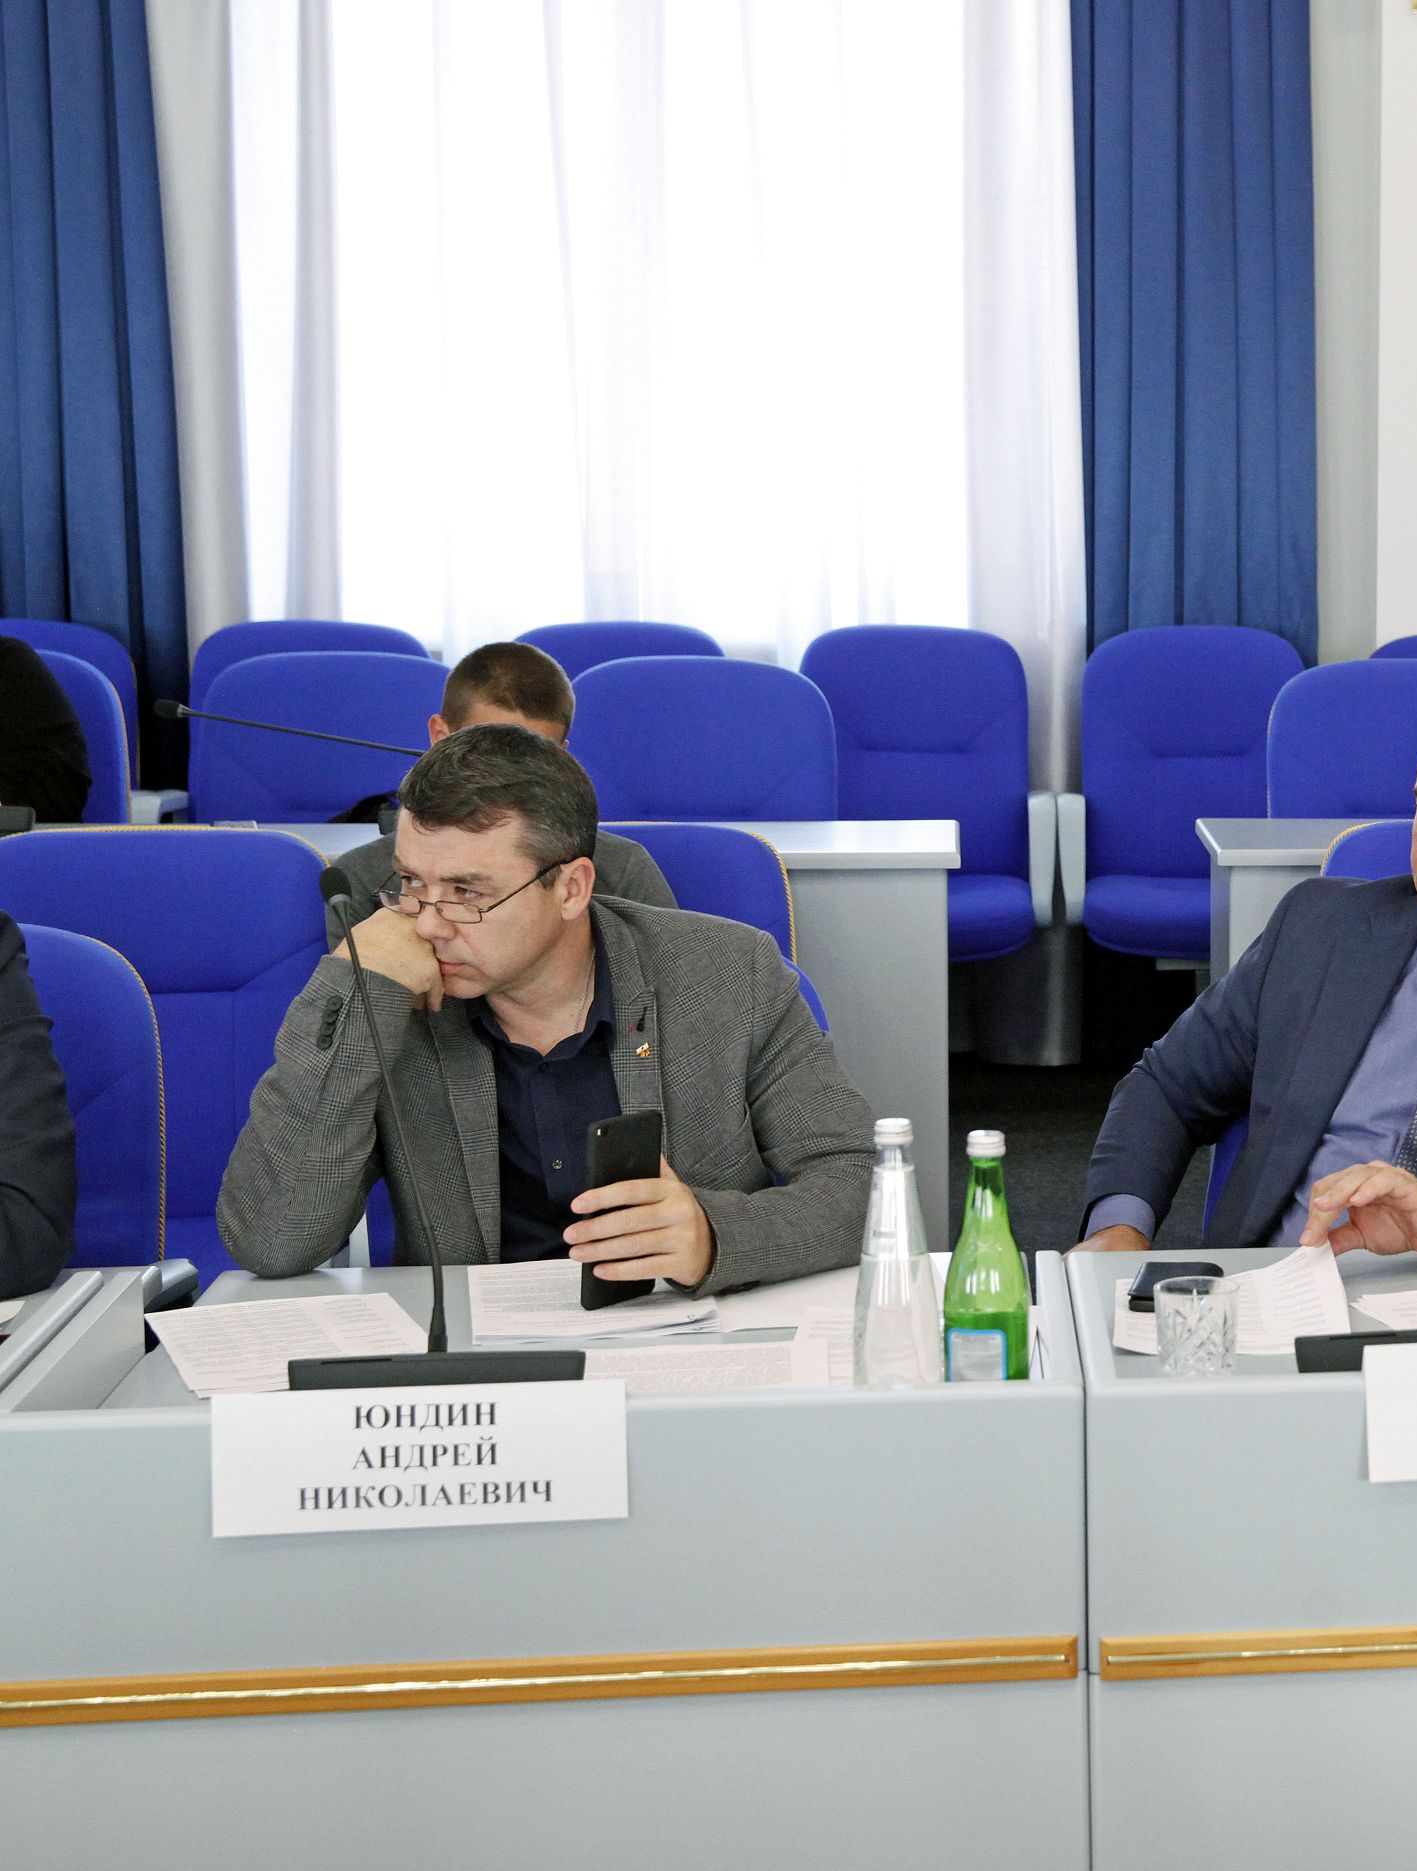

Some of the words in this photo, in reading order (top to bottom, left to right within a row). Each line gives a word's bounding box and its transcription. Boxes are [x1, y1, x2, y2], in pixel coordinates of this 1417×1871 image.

[353, 1402, 498, 1432] ЮНДИН
[352, 1436, 498, 1472] АНДРЕЙ
[299, 1479, 554, 1511] НИКОЛАЕВИЧ
